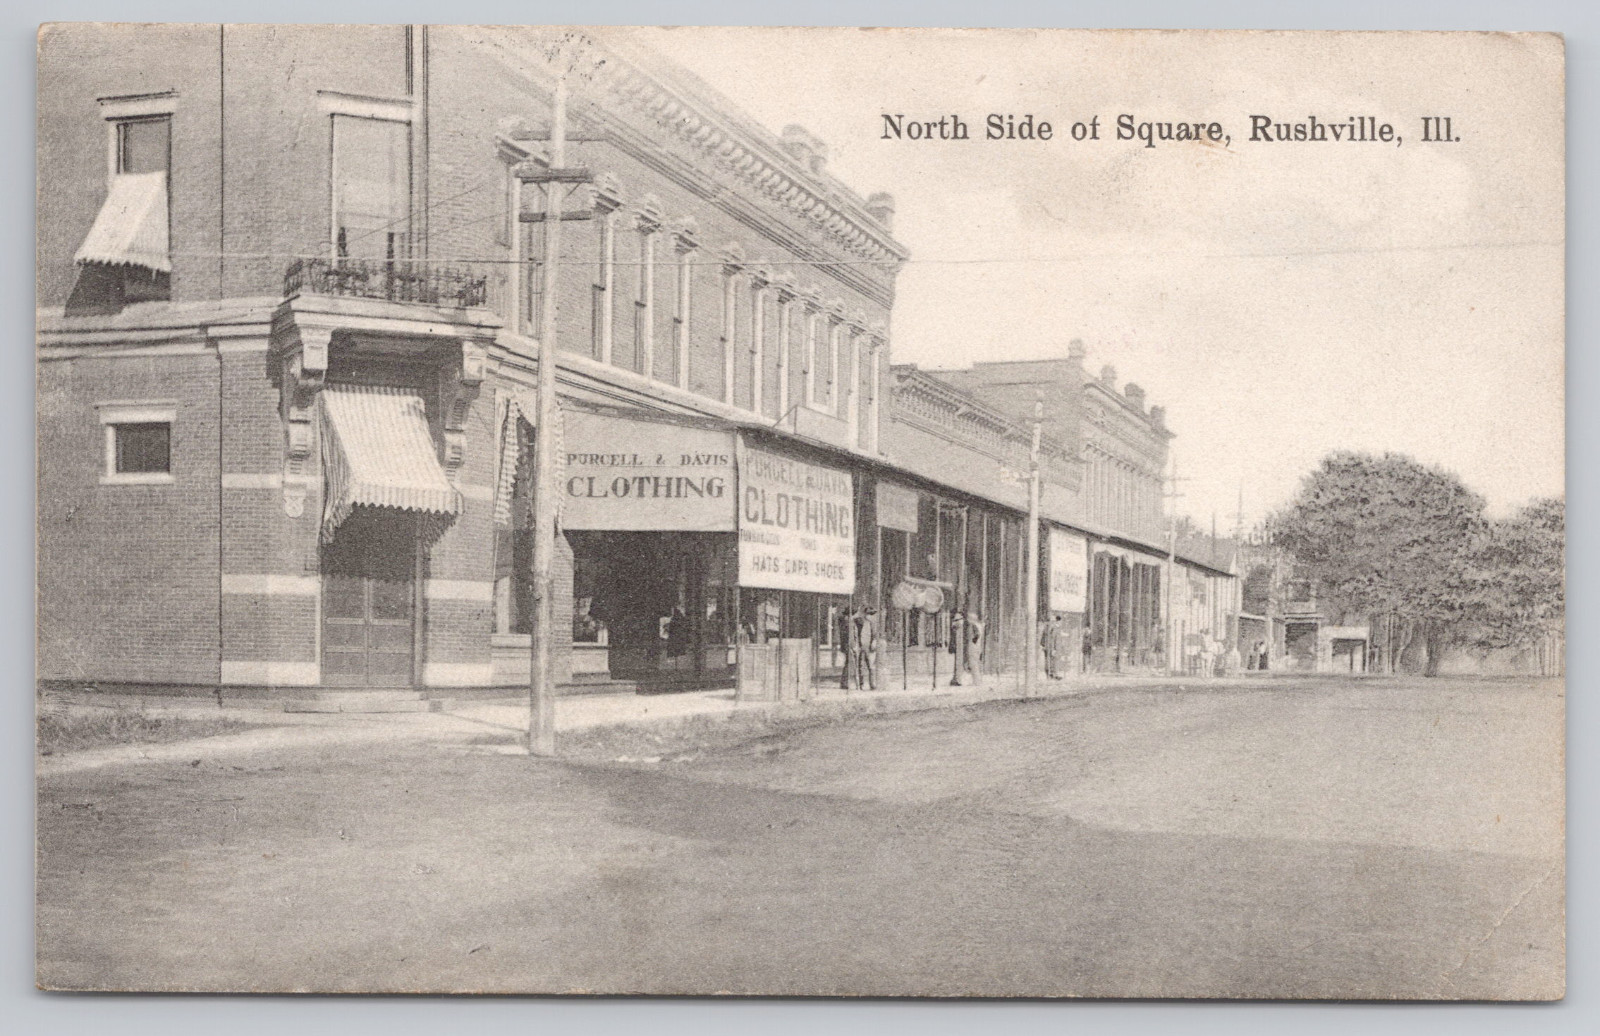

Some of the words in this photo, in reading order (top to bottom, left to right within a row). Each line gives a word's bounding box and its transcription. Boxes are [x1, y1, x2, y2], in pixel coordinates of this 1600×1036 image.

[566, 453, 643, 466] PURCELL
[656, 454, 666, 465] &
[680, 454, 729, 466] DAVIS
[566, 476, 725, 498] CLOTHING
[745, 486, 849, 538] CLOTHING
[752, 556, 779, 573] HATS
[784, 558, 809, 576] CAPS
